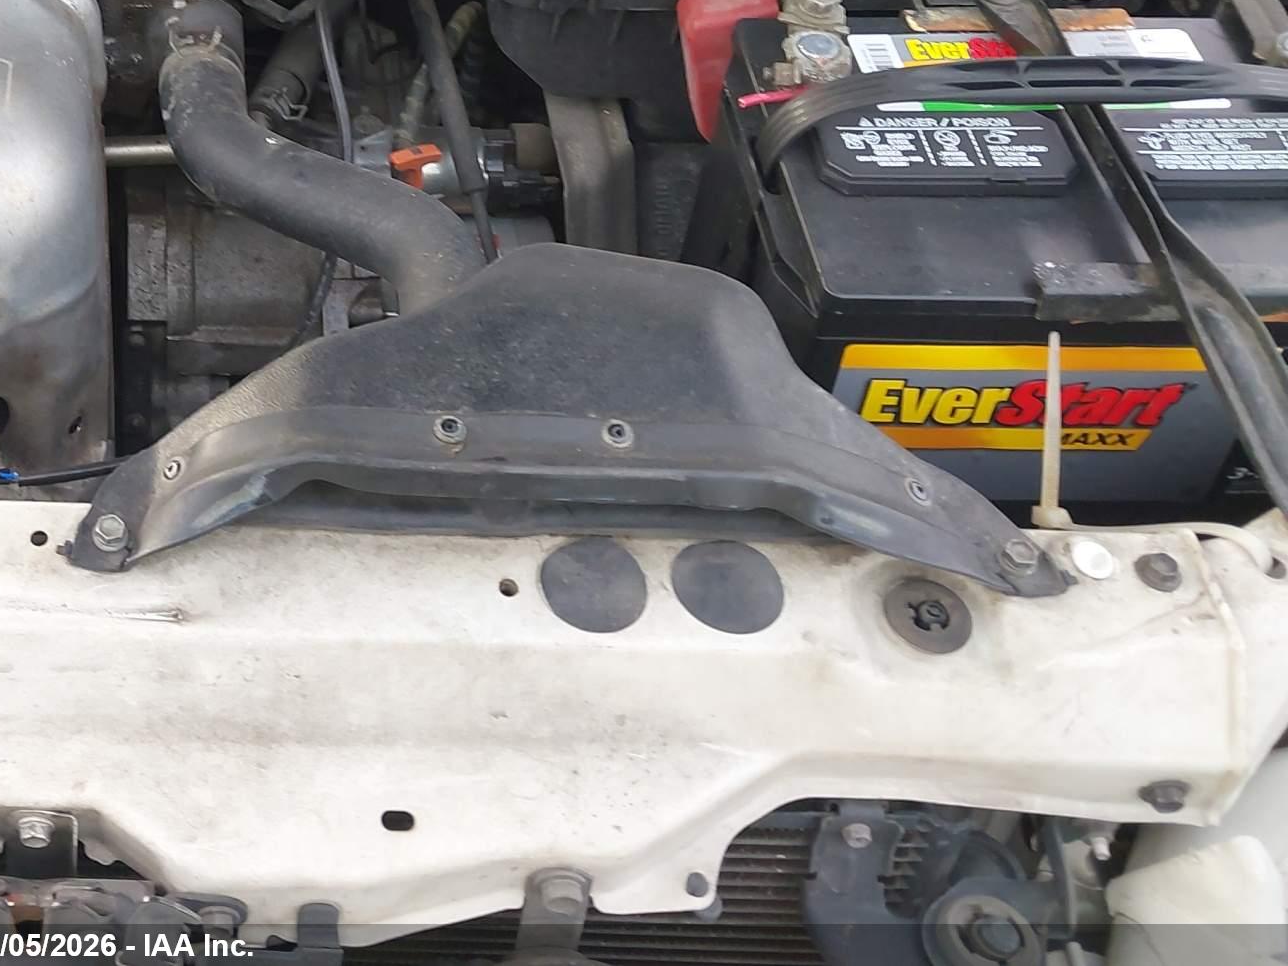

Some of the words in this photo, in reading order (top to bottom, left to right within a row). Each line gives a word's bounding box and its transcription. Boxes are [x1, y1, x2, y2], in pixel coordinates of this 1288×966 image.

[904, 37, 1017, 61] EverSta
[873, 117, 938, 127] DANGER
[951, 117, 1012, 127] POISON
[862, 378, 1186, 426] EverStart
